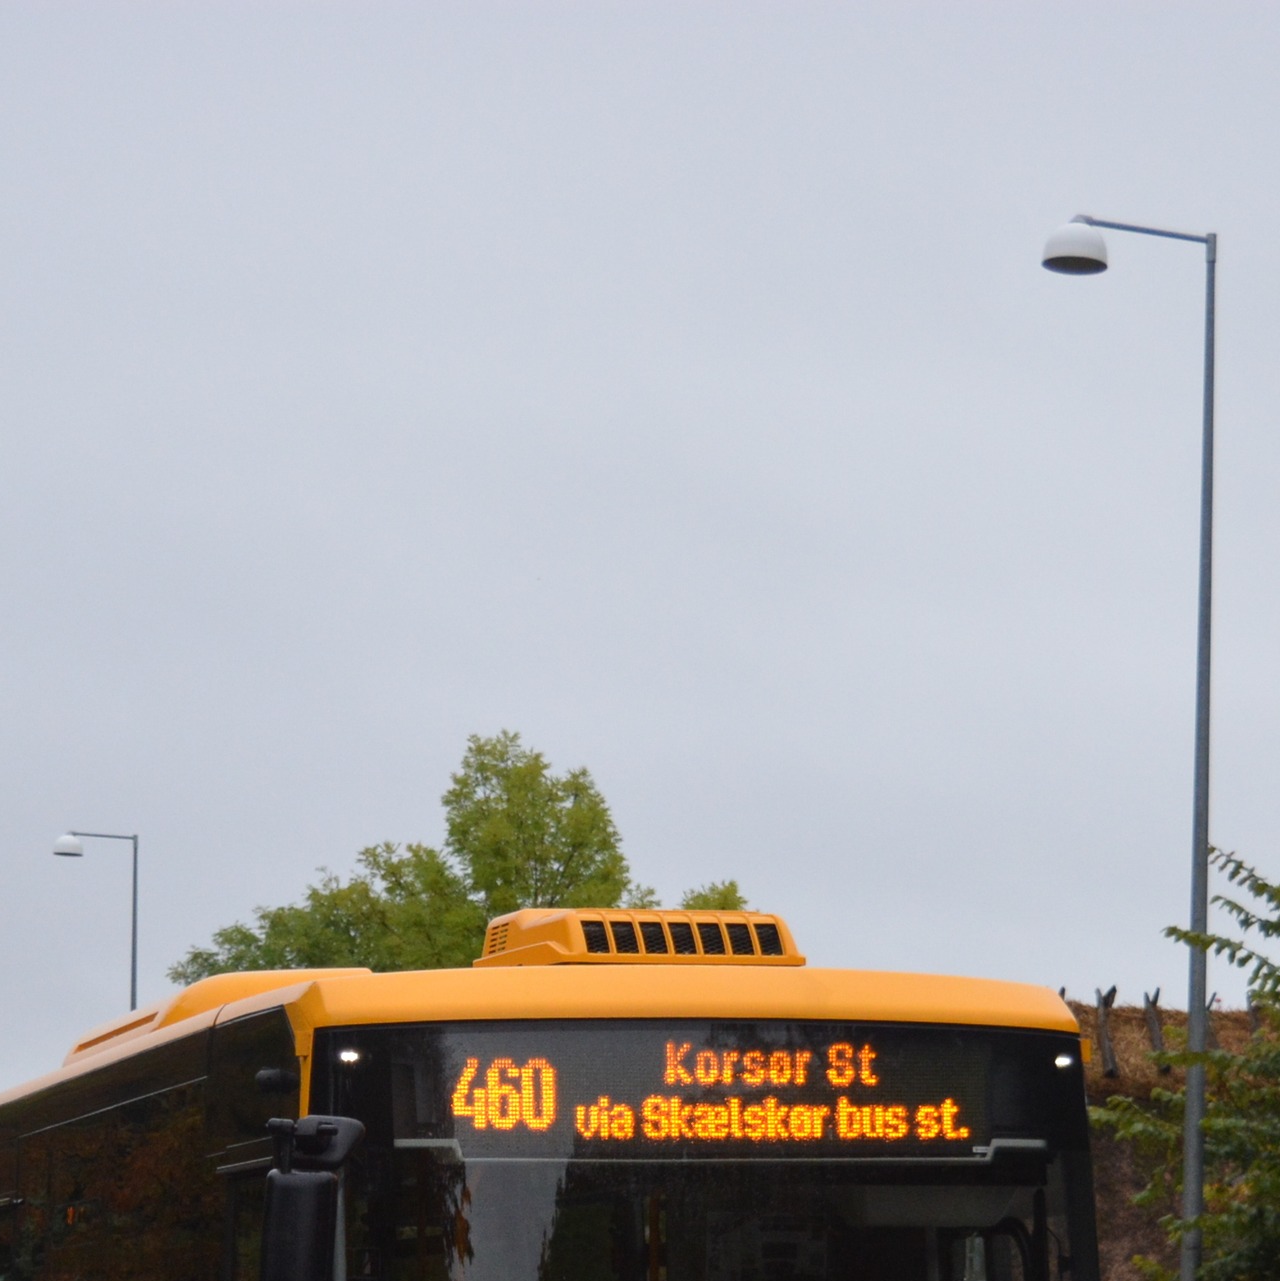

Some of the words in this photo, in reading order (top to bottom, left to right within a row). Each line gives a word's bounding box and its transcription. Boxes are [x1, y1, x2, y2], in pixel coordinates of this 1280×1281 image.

[825, 1040, 878, 1088] St
[451, 1056, 557, 1130] 460
[574, 1096, 635, 1139] via
[837, 1097, 907, 1139] bus
[915, 1098, 971, 1139] st.
